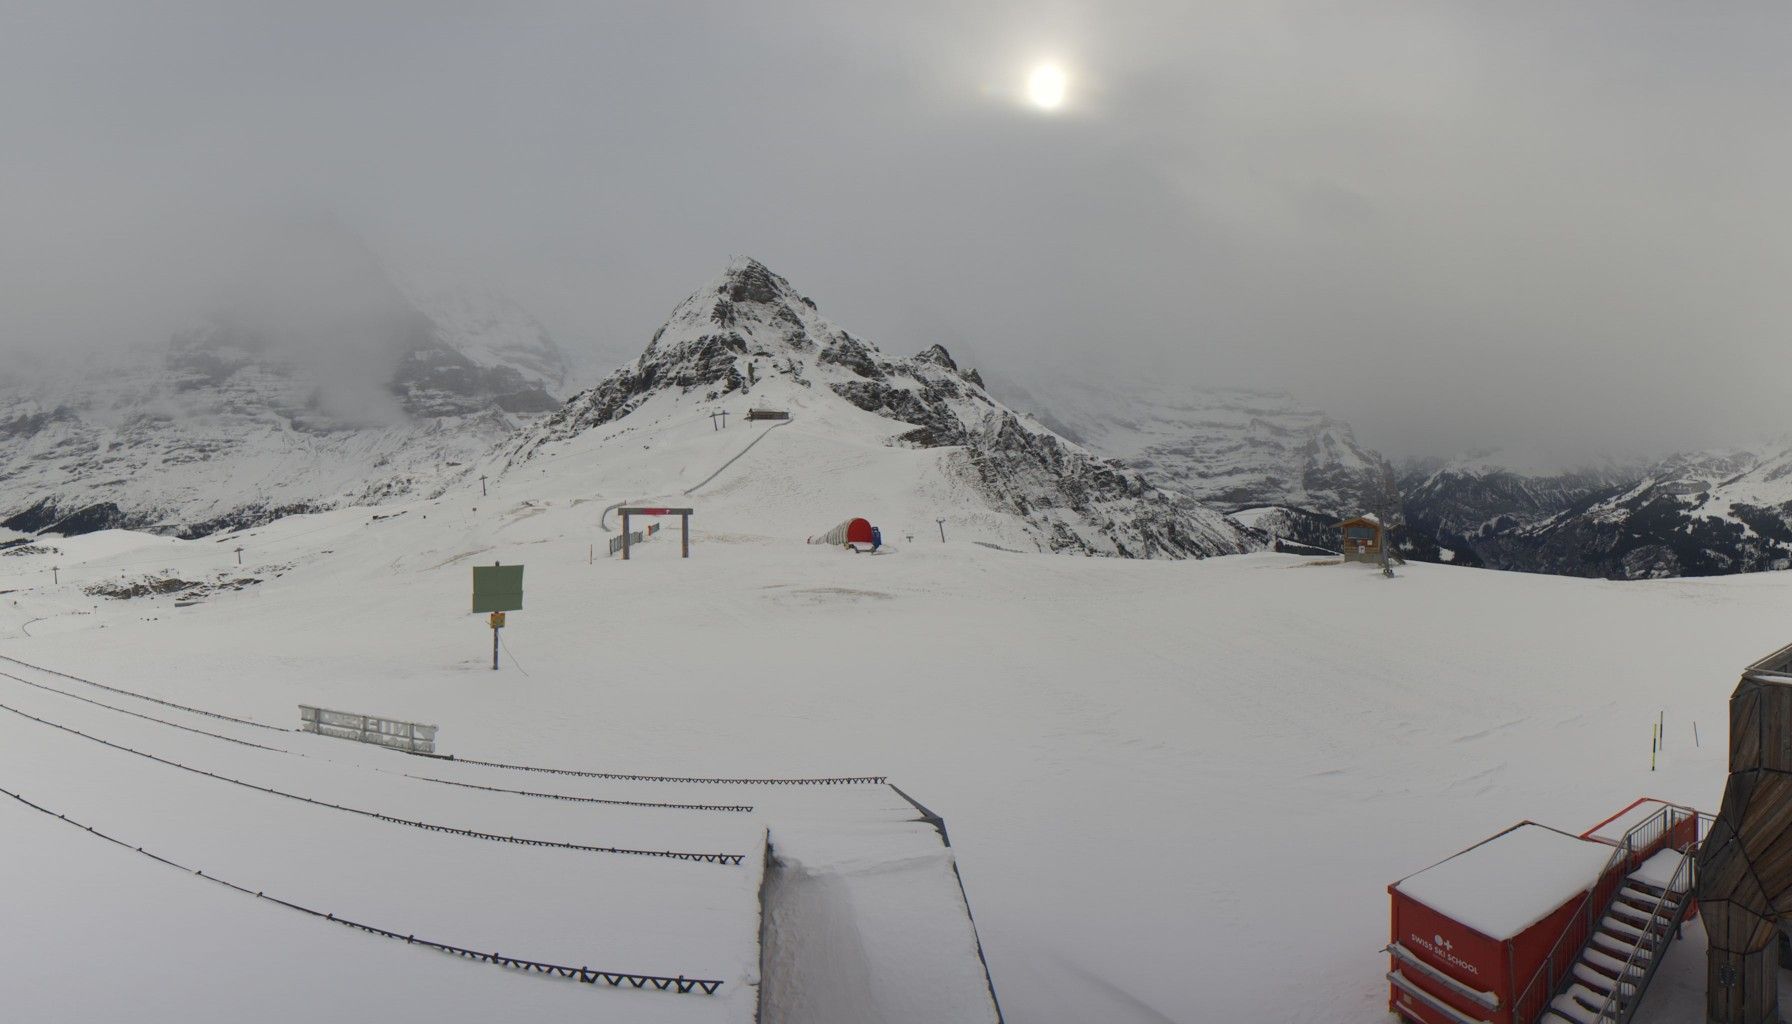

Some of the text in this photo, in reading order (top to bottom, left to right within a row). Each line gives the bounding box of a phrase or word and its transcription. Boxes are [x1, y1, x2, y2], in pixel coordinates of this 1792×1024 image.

[1411, 933, 1433, 951] SWISS
[1434, 946, 1446, 959] SKI
[1447, 954, 1480, 975] SCHOOL
